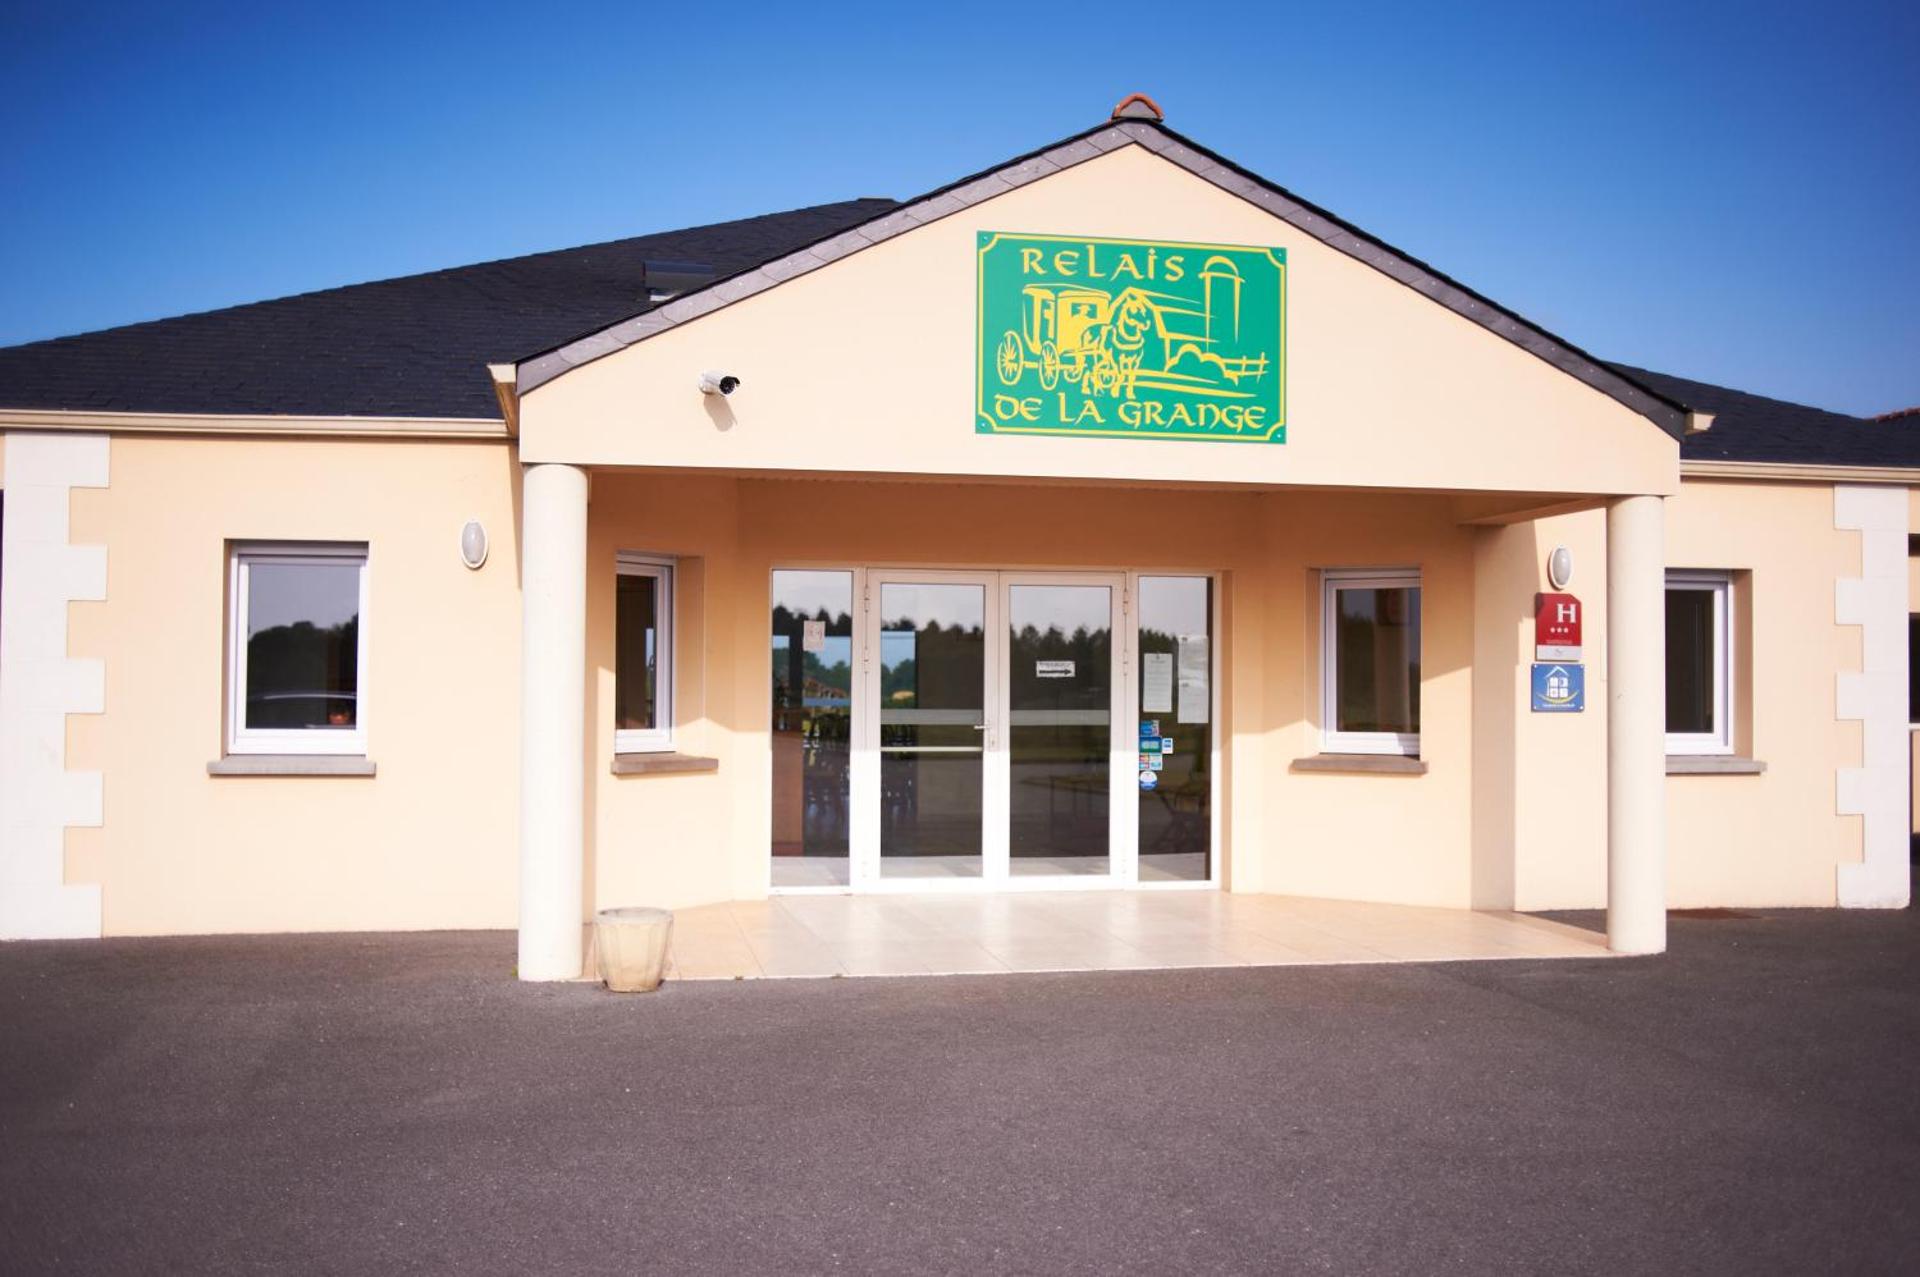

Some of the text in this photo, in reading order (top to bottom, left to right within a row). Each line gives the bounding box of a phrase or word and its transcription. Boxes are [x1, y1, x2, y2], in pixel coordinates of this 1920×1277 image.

[994, 392, 1267, 432] DE LA GRANGE
[1557, 603, 1576, 623] H
